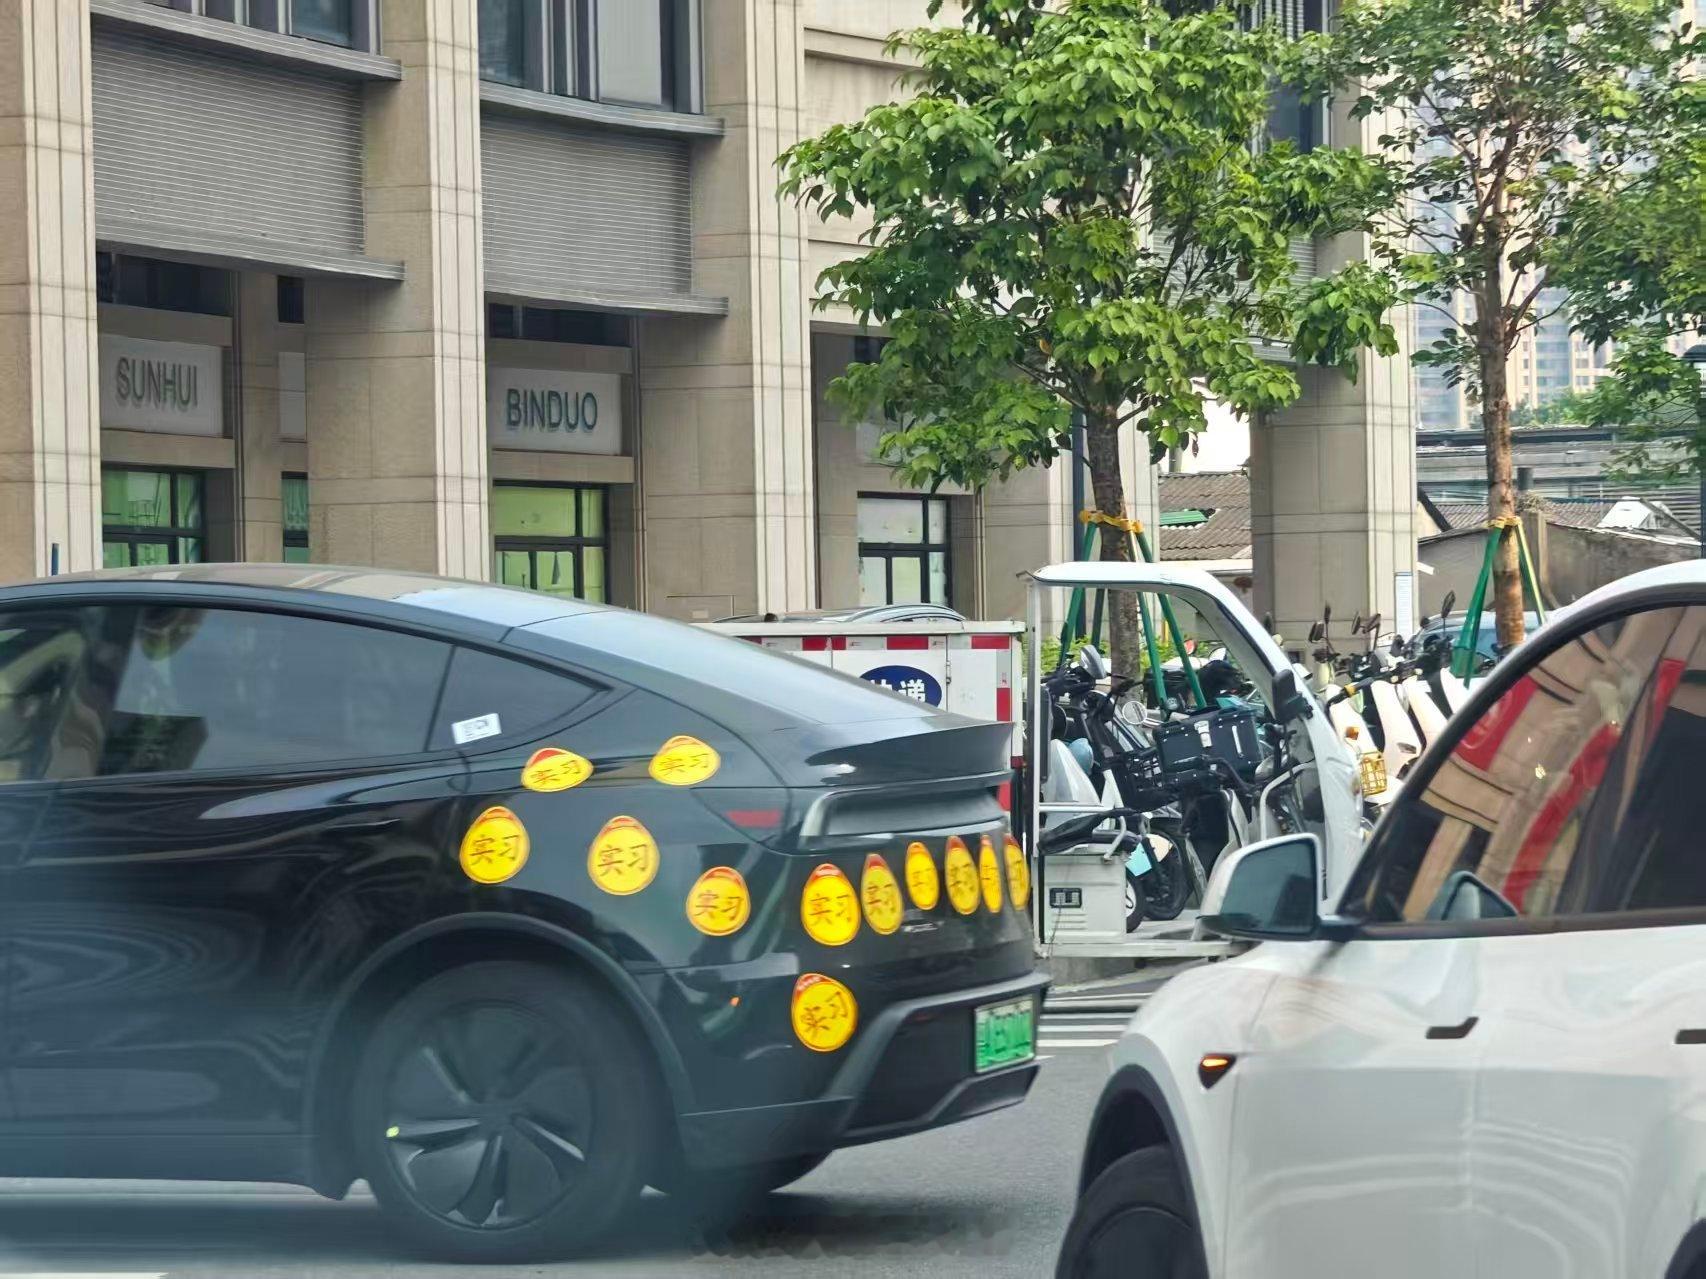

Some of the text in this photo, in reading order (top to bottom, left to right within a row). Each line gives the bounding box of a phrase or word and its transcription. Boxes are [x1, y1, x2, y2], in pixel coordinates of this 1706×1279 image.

[115, 358, 198, 408] SUNHUI
[507, 389, 597, 429] BINDUO
[531, 760, 581, 784] 实习
[660, 754, 709, 775] 实习
[470, 835, 520, 865] 实习
[597, 844, 648, 877] 实习
[694, 890, 745, 921] 实习
[810, 893, 851, 926] 实习
[800, 991, 849, 1038] 实习
